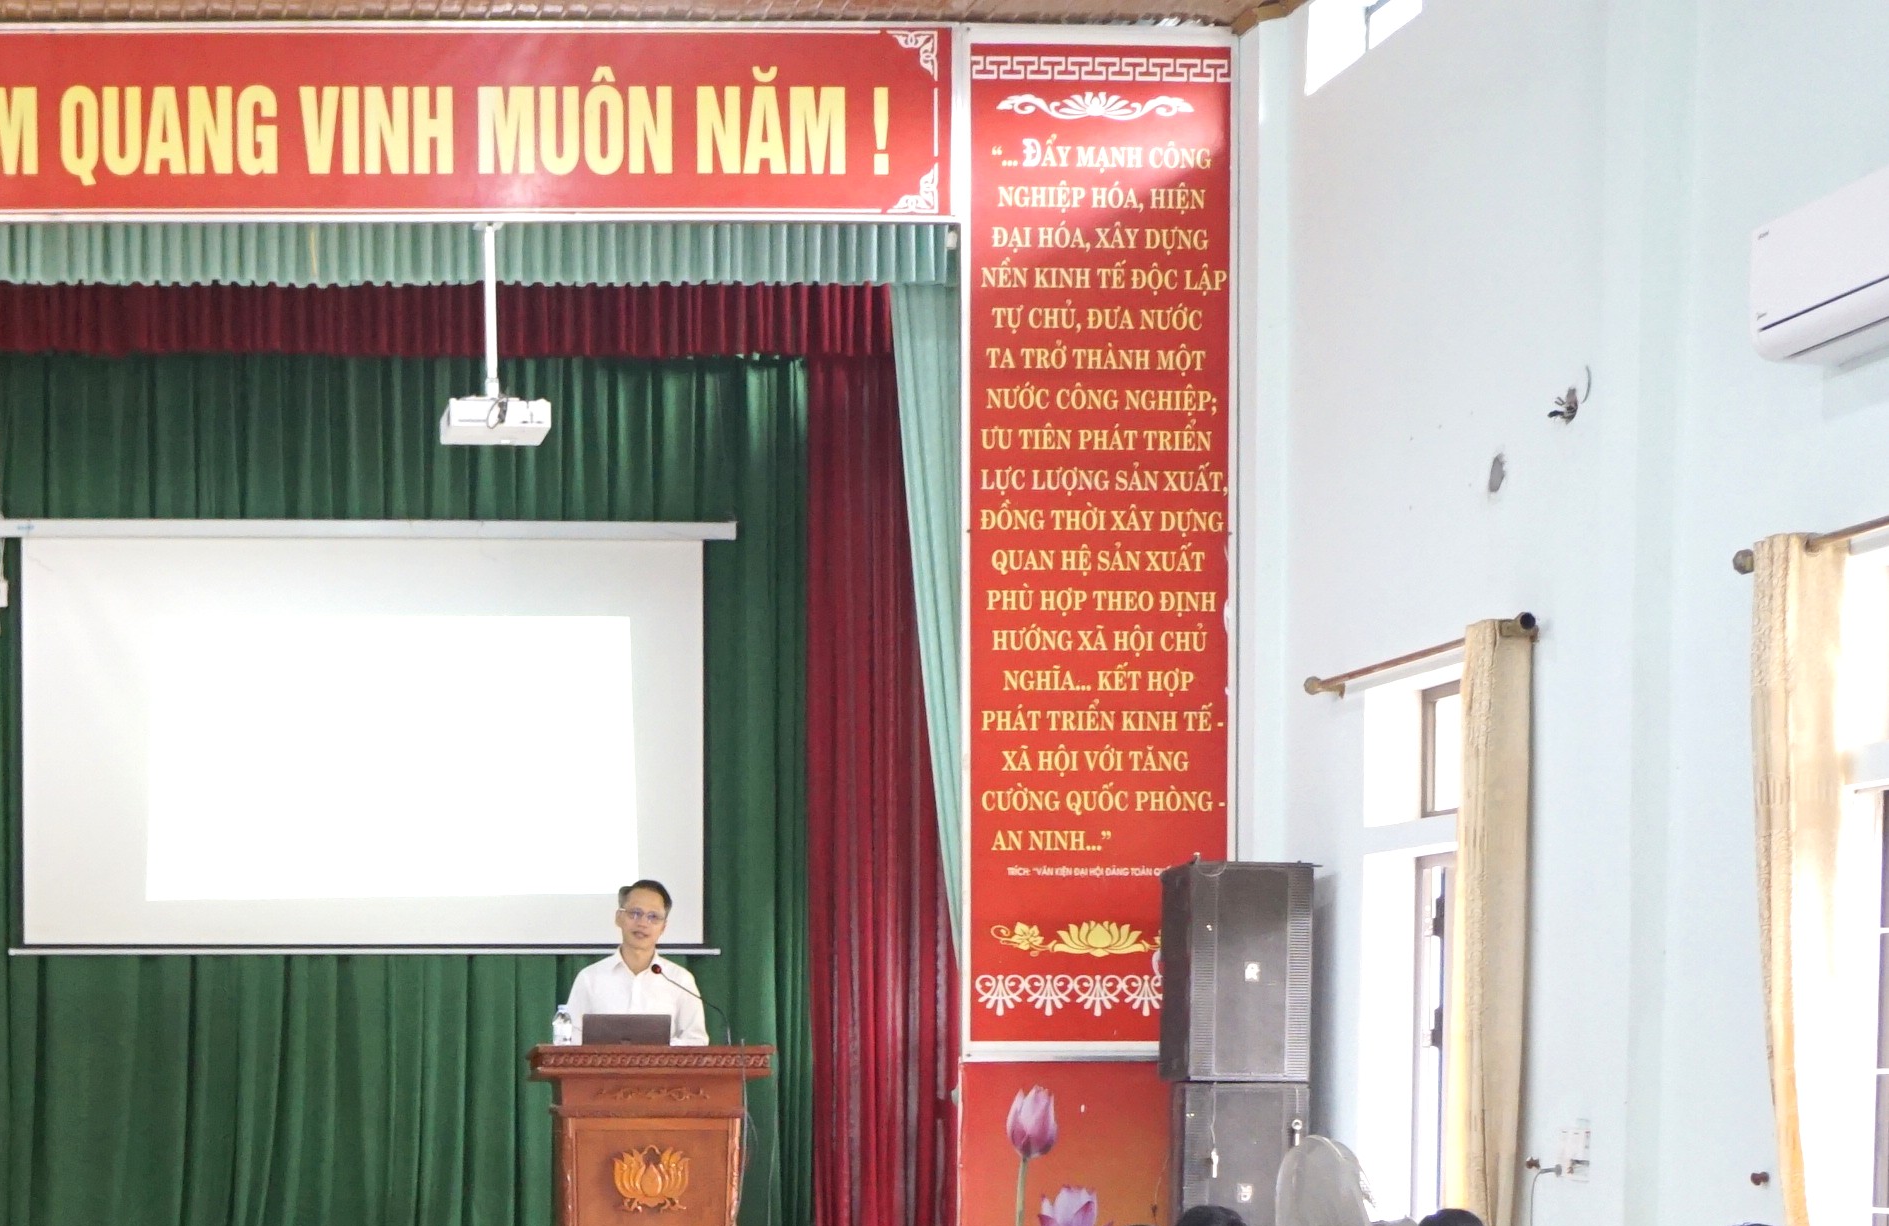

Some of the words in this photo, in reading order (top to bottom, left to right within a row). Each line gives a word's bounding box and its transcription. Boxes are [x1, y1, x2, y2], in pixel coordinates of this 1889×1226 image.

[61, 85, 278, 187] QUANG
[301, 85, 455, 176] VINH
[478, 66, 674, 176] MUÔN
[697, 66, 846, 176] NĂM
[873, 87, 889, 176] !
[1022, 133, 1072, 168] ĐẨY
[1076, 145, 1143, 174] MẠNH
[1149, 141, 1212, 169] CÔNG
[997, 180, 1085, 213] NGHIỆP
[1091, 181, 1144, 213] HÓA,
[1149, 182, 1205, 215] HIỆN
[991, 226, 1031, 253] ĐẠI
[1038, 220, 1091, 252] HÓA,
[1094, 221, 1139, 249] XÂY
[1144, 226, 1209, 255] DỰNG
[980, 257, 1028, 288] NỀN
[1033, 266, 1091, 289] KINH
[1096, 259, 1127, 290] TẾ
[1130, 262, 1178, 296] ĐỘC
[1183, 263, 1228, 296] LẬP
[992, 305, 1025, 334] TỰ
[1028, 298, 1081, 333] CHỦ,
[1086, 307, 1134, 330] ĐƯA
[1139, 302, 1203, 331] NƯỚC
[986, 347, 1015, 370] TA
[1021, 339, 1067, 370] TRỞ
[1072, 342, 1151, 371] THÀNH
[1156, 343, 1206, 377] MỘT
[986, 381, 1049, 410] NƯỚC
[1056, 382, 1118, 411] CÔNG
[1124, 383, 1218, 417] NGHIỆP;
[980, 425, 1013, 450] ƯU
[1018, 422, 1072, 450] TIÊN
[1077, 423, 1138, 451] PHÁT
[1143, 418, 1212, 452] TRIỂN
[980, 466, 1025, 496] LỰC
[1031, 466, 1110, 497] LƯỢNG
[1114, 461, 1159, 492] SẢN
[1163, 462, 1229, 497] XUẤT,
[980, 499, 1045, 531] ĐỒNG
[1050, 502, 1106, 532] THỜI
[1110, 503, 1155, 532] XÂY
[1159, 508, 1224, 538] DỰNG
[991, 549, 1055, 576] QUAN
[1060, 543, 1092, 577] HỆ
[1097, 541, 1140, 572] SẢN
[1145, 542, 1205, 572] XUẤT
[986, 582, 1034, 611] PHÙ
[1039, 587, 1087, 617] HỢP
[1092, 590, 1154, 612] THEO
[1159, 591, 1217, 618] ĐỊNH
[991, 623, 1073, 651] HƯỚNG
[1077, 624, 1108, 651] XÃ
[1113, 624, 1154, 657] HỘI
[1159, 623, 1208, 653] CHỦ
[1002, 664, 1092, 692] NGHĨA...
[1097, 662, 1142, 692] KẾT
[1146, 669, 1195, 697] HỢP
[981, 703, 1041, 732] PHÁT
[1046, 698, 1115, 732] TRIỂN
[1121, 710, 1178, 732] KINH
[1183, 702, 1213, 732] TẾ
[1001, 744, 1032, 772] XÃ
[1037, 744, 1078, 777] HỘI
[1083, 744, 1123, 772] VỚI
[1128, 745, 1189, 772] TĂNG
[981, 782, 1061, 812] CƯỜNG
[1066, 782, 1130, 816] QUỐC
[1134, 784, 1213, 813] PHÒNG
[991, 830, 1023, 851] AN
